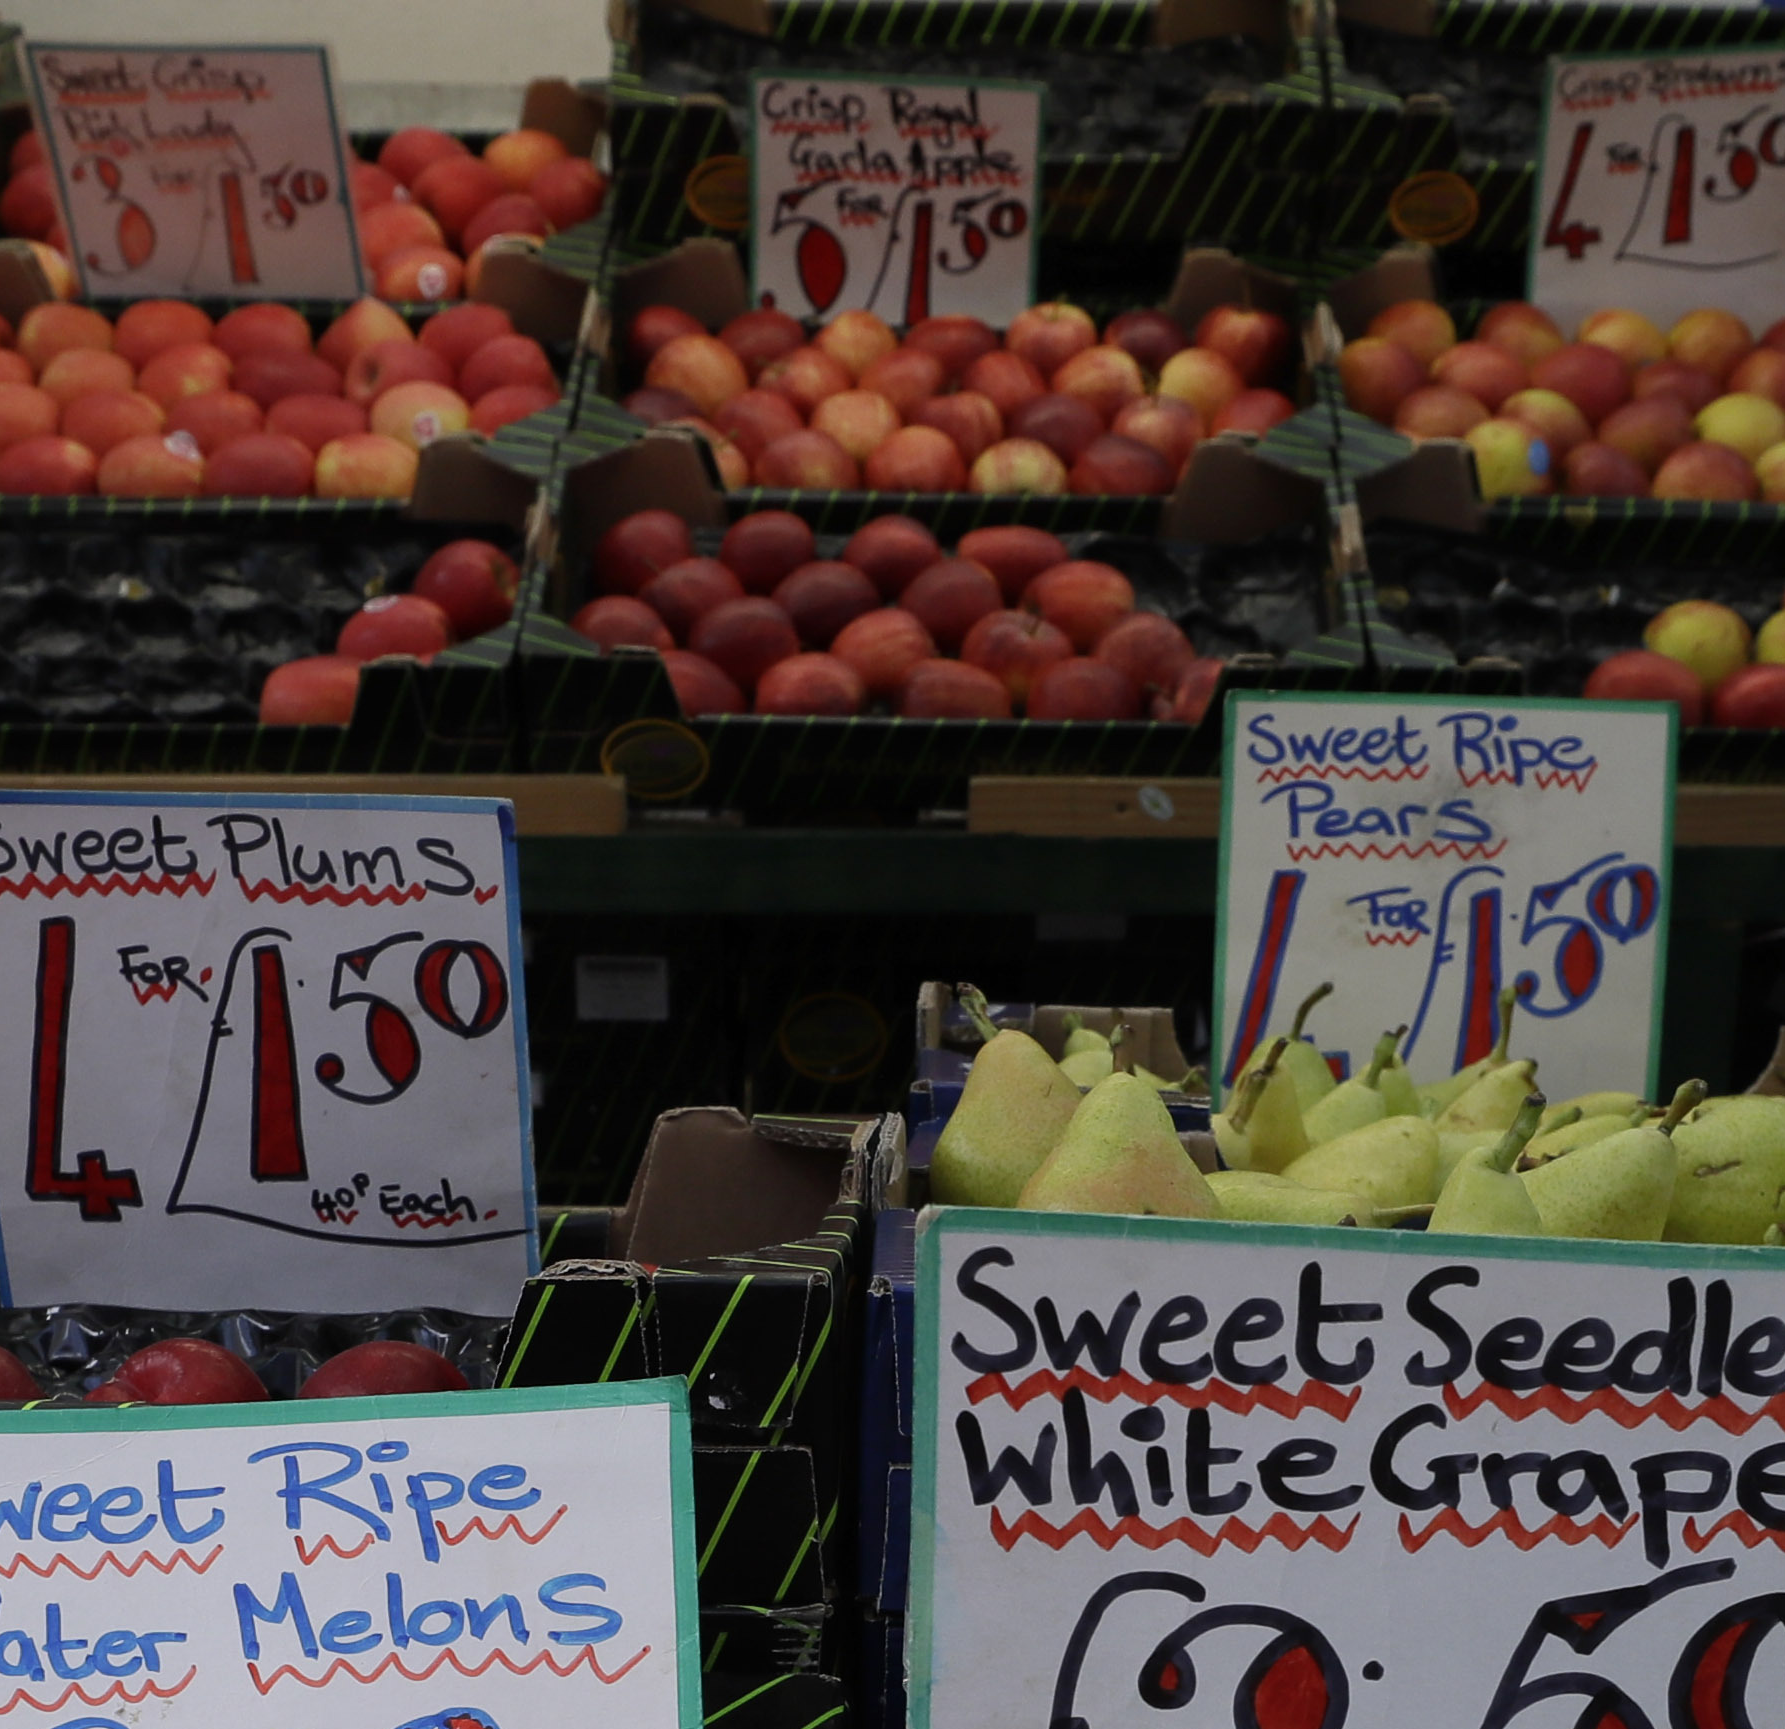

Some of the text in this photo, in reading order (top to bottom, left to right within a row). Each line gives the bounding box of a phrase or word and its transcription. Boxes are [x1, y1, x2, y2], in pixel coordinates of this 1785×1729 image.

[762, 82, 867, 134] Crisp
[1248, 711, 1598, 787] Sweet Ripe
[206, 812, 477, 897] Plums
[1260, 780, 1494, 842] Pears
[25, 916, 144, 1223] 4
[379, 1178, 479, 1222] Each
[950, 1246, 1385, 1388] Sweet
[954, 1387, 1367, 1520] White
[246, 1440, 547, 1562] Ripe
[233, 1571, 625, 1662] Melons
